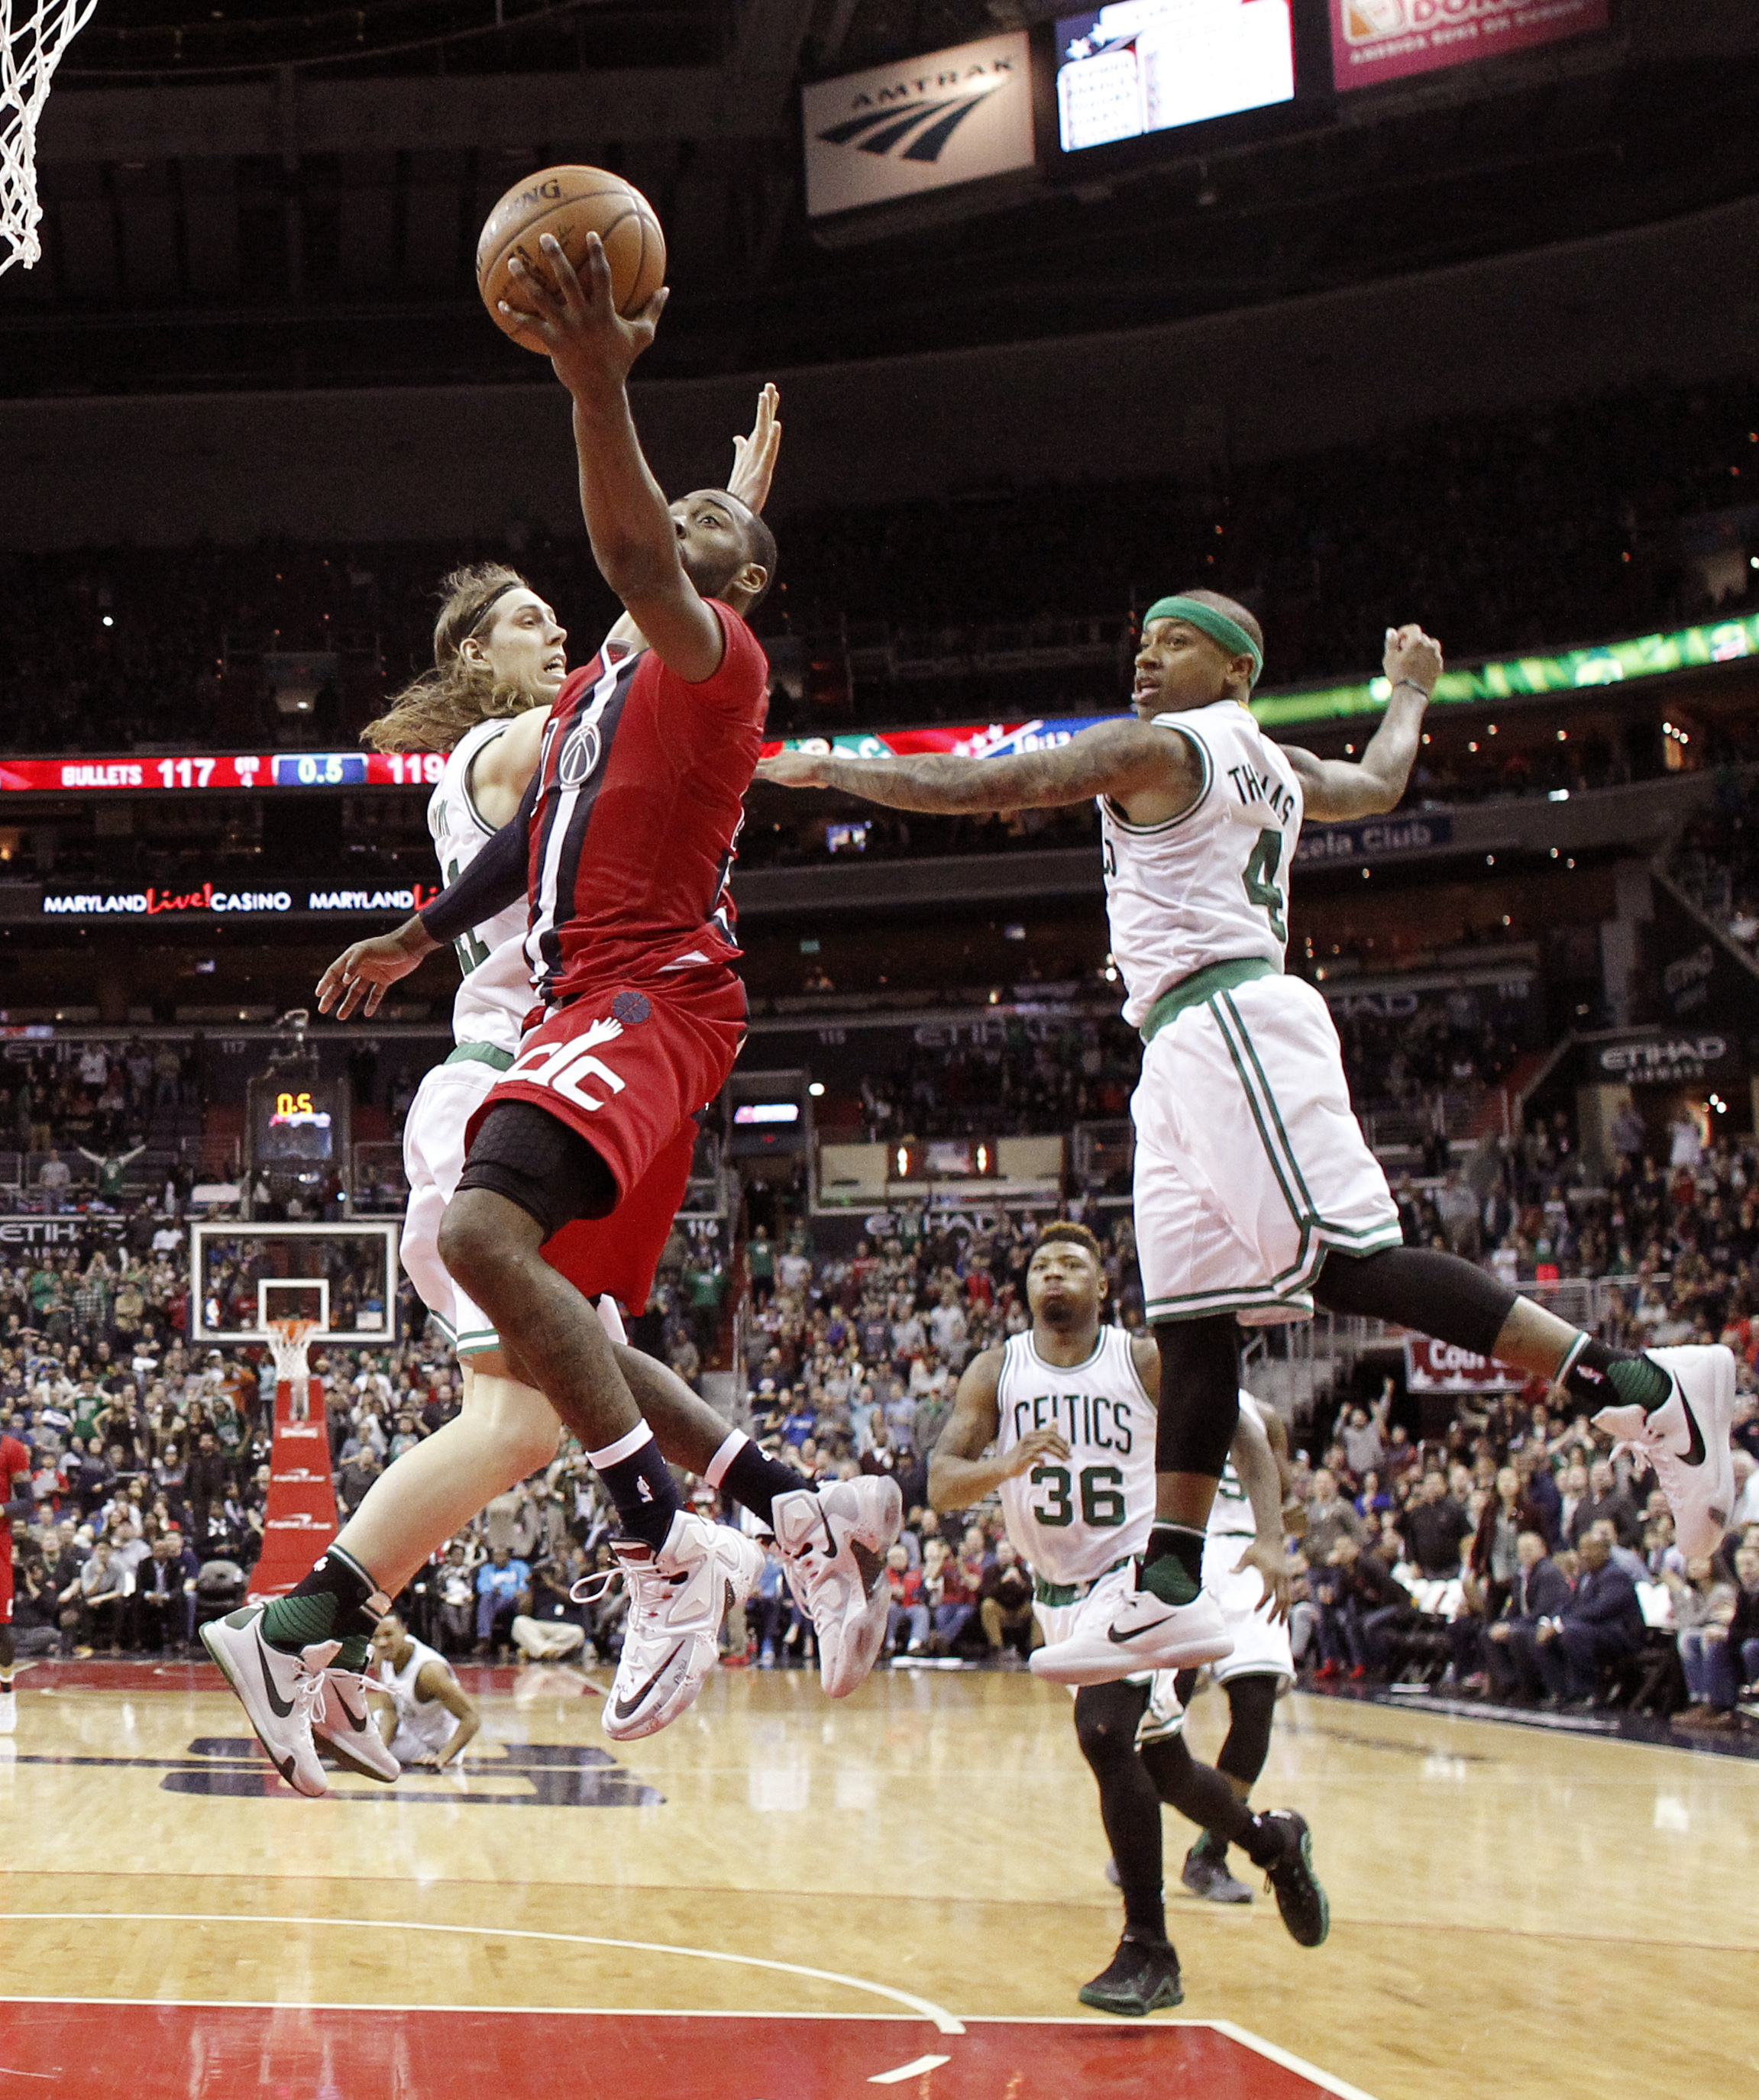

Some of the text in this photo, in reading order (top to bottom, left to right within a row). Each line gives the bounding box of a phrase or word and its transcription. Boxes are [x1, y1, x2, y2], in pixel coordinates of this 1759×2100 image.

[851, 55, 1014, 109] AMTRAK
[62, 754, 445, 788] BULLETS 117 0.5 119
[1363, 822, 1432, 852] Club
[44, 883, 292, 915] MARYLAND Live! CASINO
[309, 890, 415, 910] MARYLAND
[1242, 827, 1287, 943] 4
[1601, 1036, 1728, 1070] ETIHAD
[276, 1092, 314, 1117] 0.5
[1030, 1466, 1126, 1527] 36
